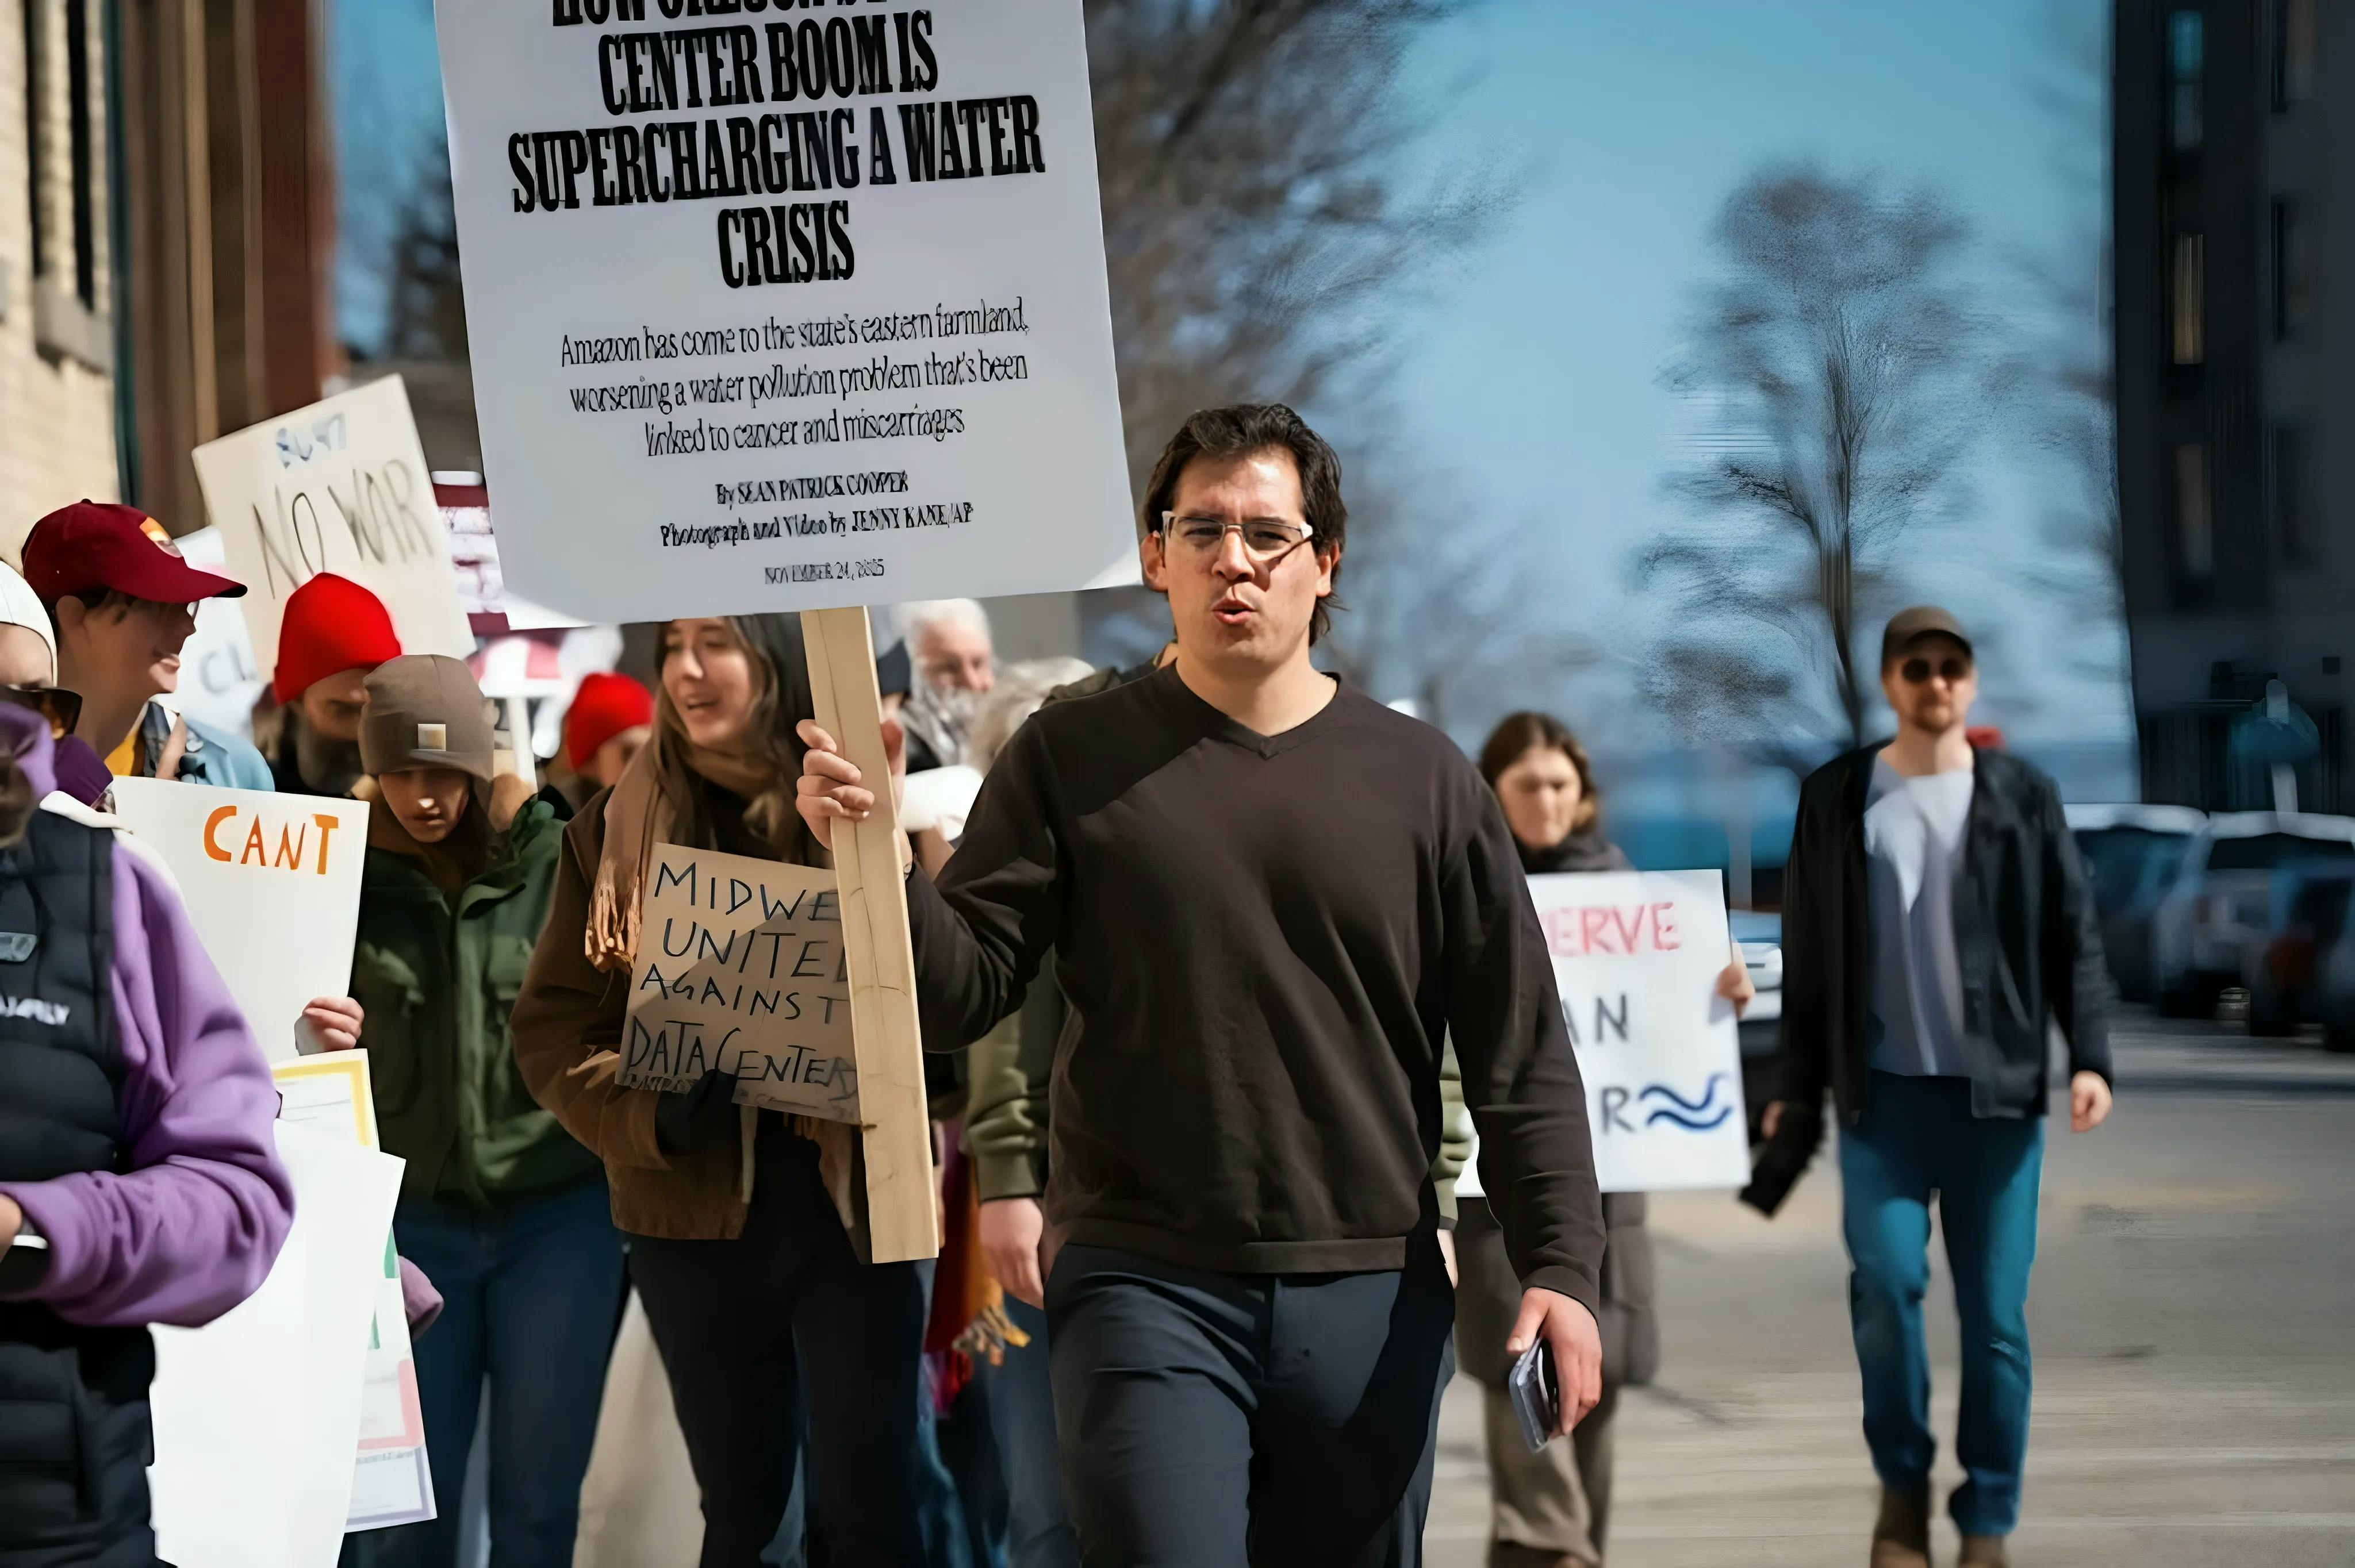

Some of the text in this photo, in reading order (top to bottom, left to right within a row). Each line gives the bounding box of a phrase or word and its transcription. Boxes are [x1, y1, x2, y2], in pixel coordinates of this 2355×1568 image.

[599, 10, 938, 115] CENTER BOOM IS
[508, 95, 1046, 213] SUPERCHARGING A WATER
[717, 201, 854, 289] CRISIS
[562, 335, 641, 367] Amazon
[643, 326, 678, 358] has
[681, 329, 735, 355] come
[739, 328, 759, 352] to
[762, 317, 795, 349] the
[861, 312, 933, 343] eastern
[570, 376, 672, 414] worsening
[675, 382, 687, 406] a
[689, 372, 744, 402] water
[749, 364, 836, 408] pollution
[840, 356, 920, 401] problem
[978, 348, 1027, 381] been
[645, 403, 965, 456] linked to cancer and miscarriages
[252, 485, 324, 599] NO
[328, 459, 434, 564] WAR
[715, 484, 734, 510] By
[204, 805, 339, 875] CANT
[654, 862, 841, 921] MIDWE
[1544, 902, 1682, 956] ERVE
